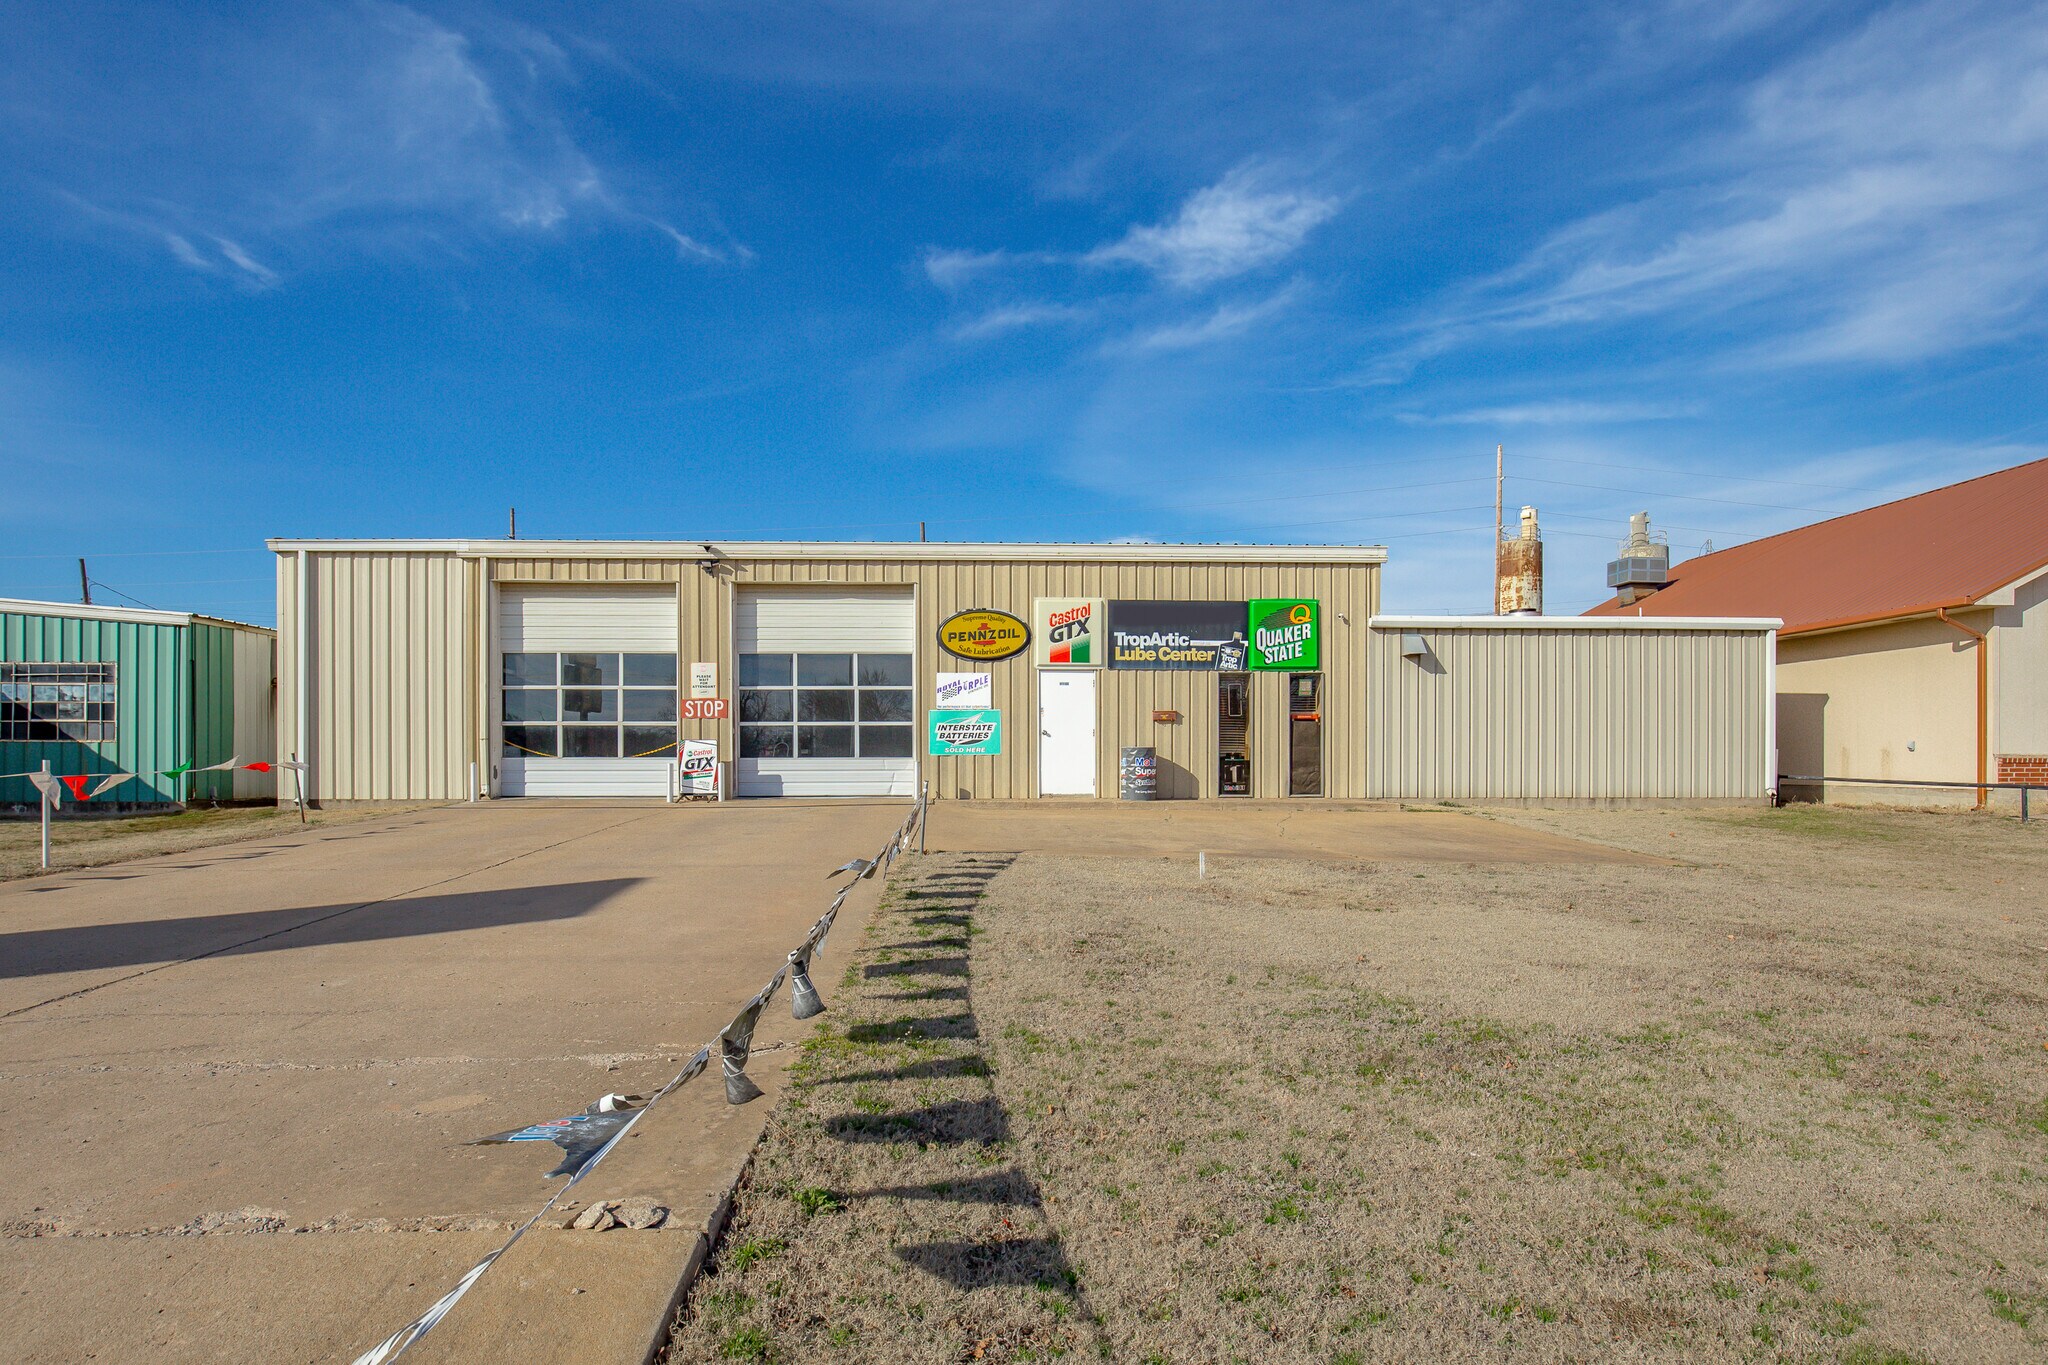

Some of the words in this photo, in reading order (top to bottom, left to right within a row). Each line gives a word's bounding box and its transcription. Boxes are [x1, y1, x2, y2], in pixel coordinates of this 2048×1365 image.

[962, 615, 987, 623] Supreme
[987, 614, 1007, 624] Quality
[1049, 603, 1091, 628] Castrol
[948, 629, 1020, 643] PENNZOIL
[1050, 617, 1091, 644] GTX
[1256, 623, 1312, 653] QUAKER
[1114, 631, 1189, 649] TropArtic
[958, 644, 973, 654] Safe
[973, 645, 1011, 655] Lubrication
[1114, 647, 1157, 662] Lube
[1158, 647, 1215, 662] Center
[1264, 642, 1303, 665] STATE
[1221, 653, 1238, 663] Trop
[936, 679, 961, 694] ROYAL
[957, 675, 989, 695] PURPLE
[685, 700, 724, 717] STOP
[685, 756, 715, 771] GTX
